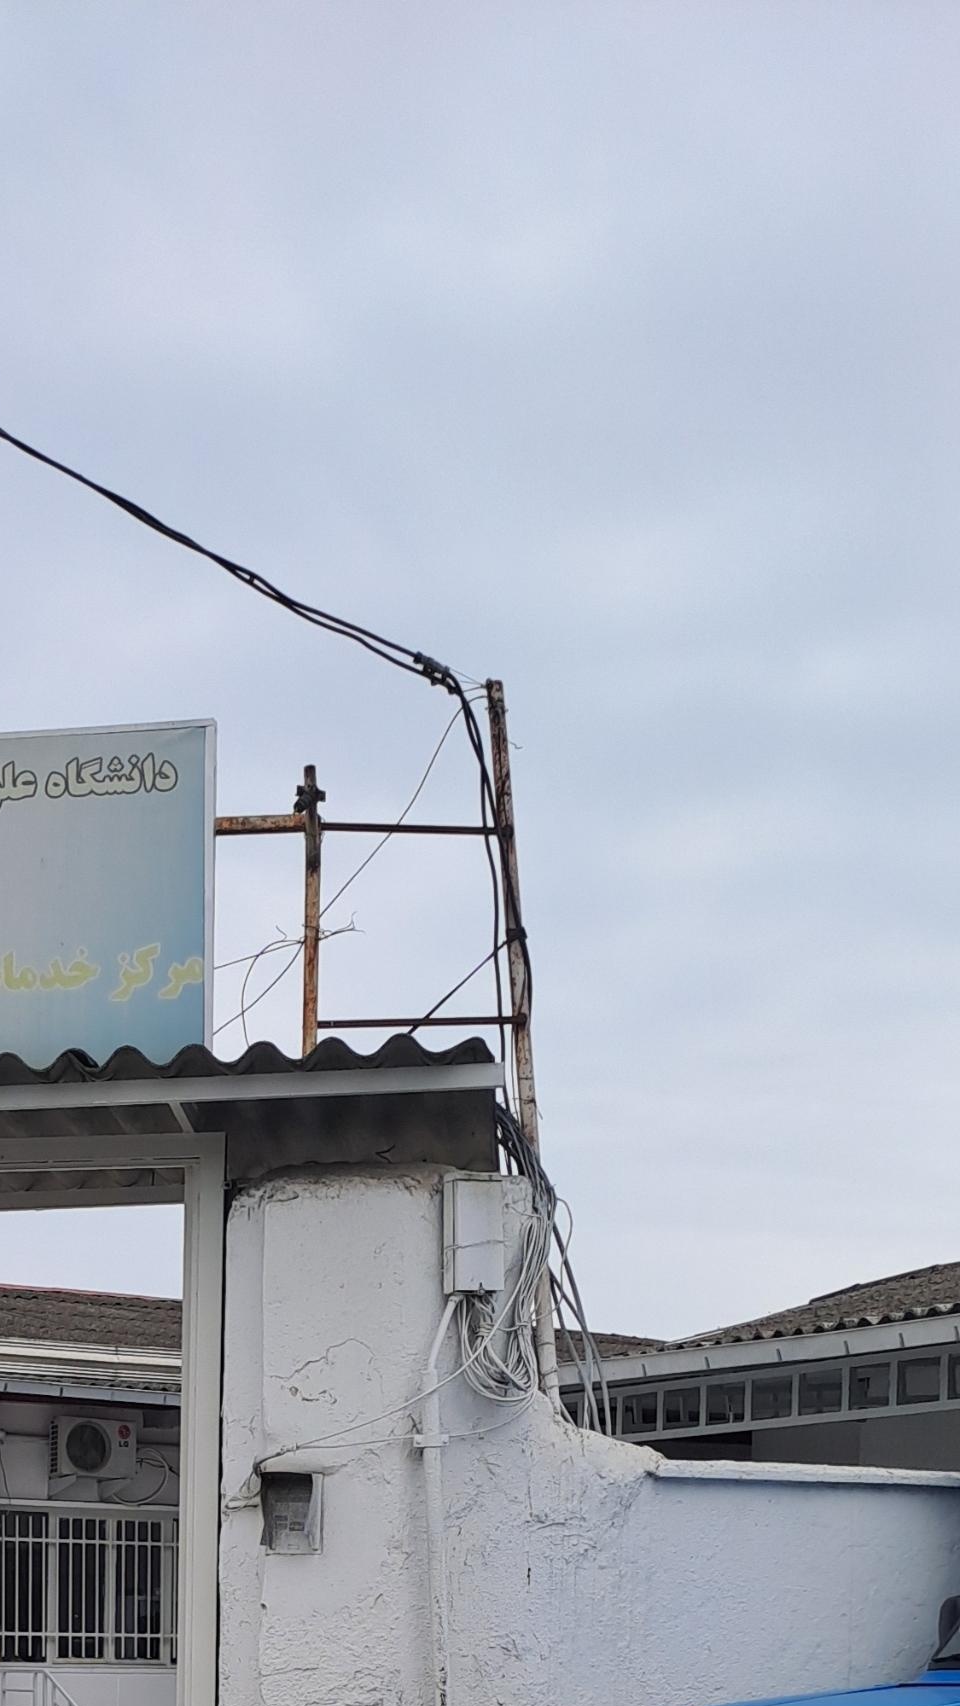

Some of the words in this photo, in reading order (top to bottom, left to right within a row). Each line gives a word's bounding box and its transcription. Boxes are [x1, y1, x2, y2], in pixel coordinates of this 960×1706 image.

[45, 752, 178, 798] دانشگاه
[108, 942, 205, 1001] مرکز
[118, 1440, 129, 1448] LG
